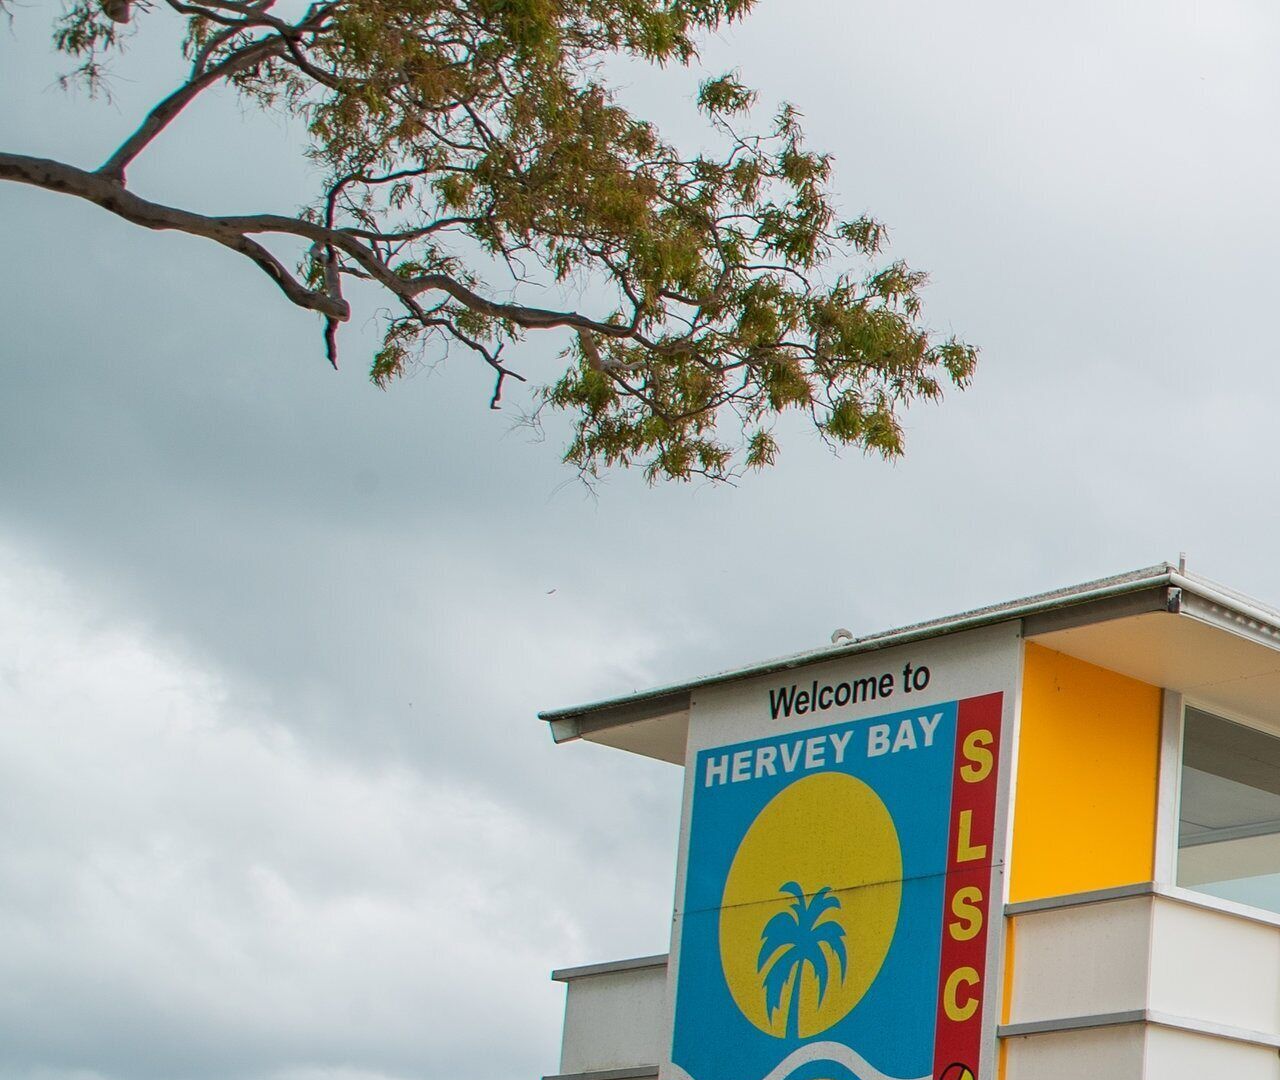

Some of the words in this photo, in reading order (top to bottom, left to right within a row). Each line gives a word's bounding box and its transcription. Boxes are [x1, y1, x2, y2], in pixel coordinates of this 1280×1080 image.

[769, 673, 894, 720] Welcome
[903, 662, 930, 693] to
[705, 731, 854, 788] HERVEY
[867, 713, 943, 758] BAY
